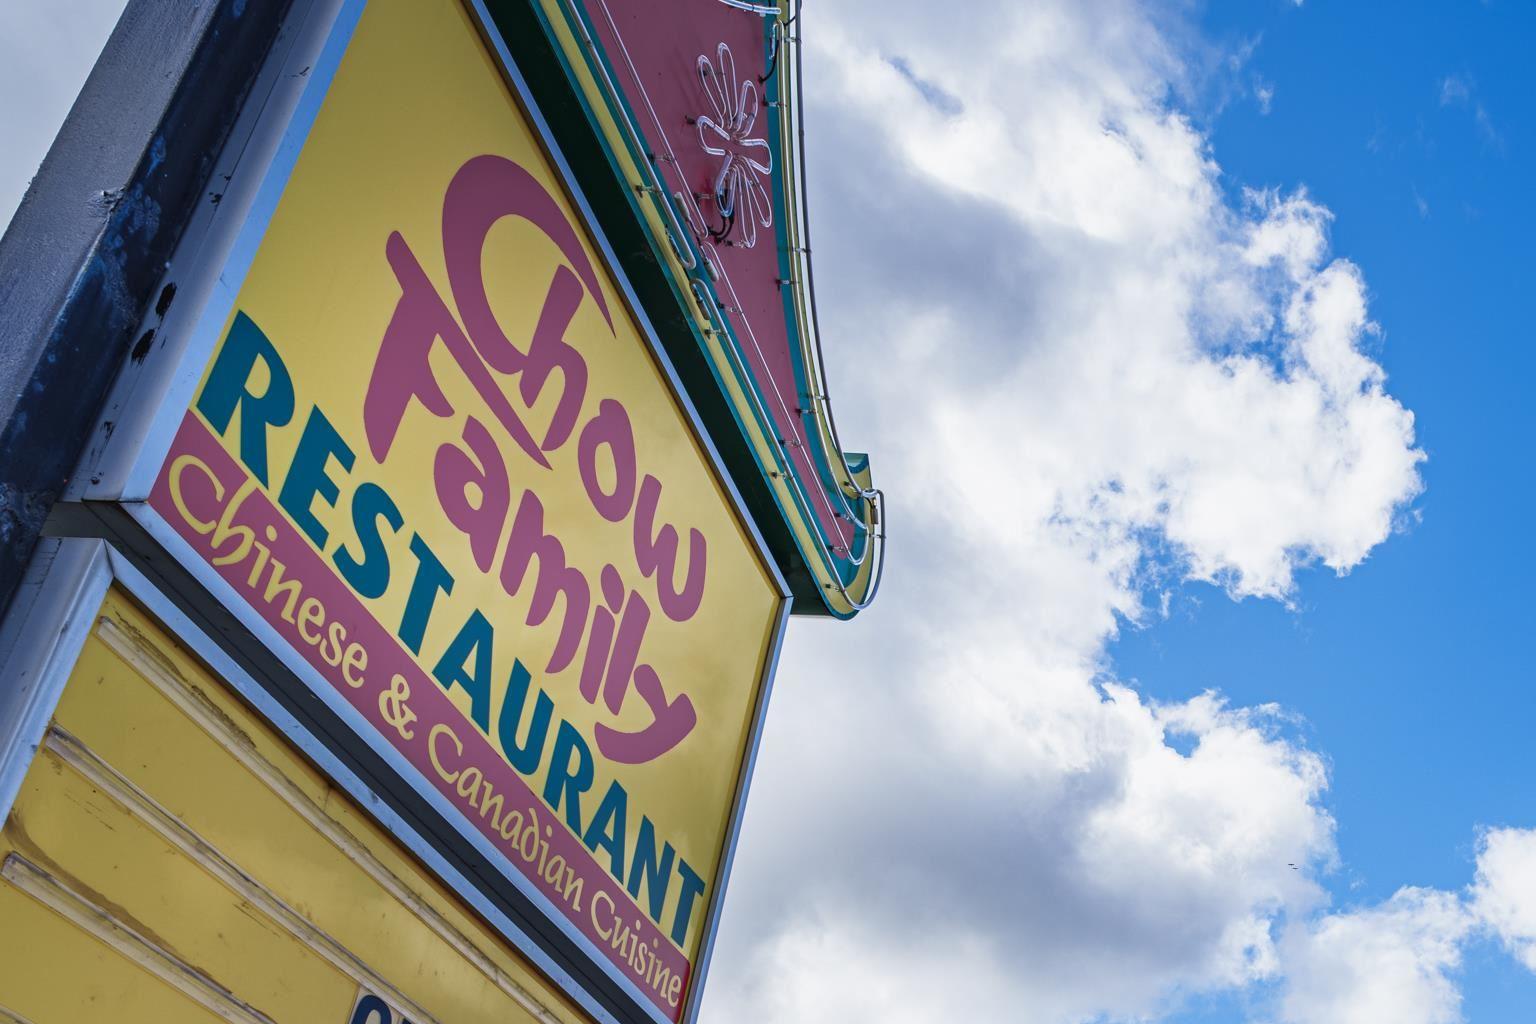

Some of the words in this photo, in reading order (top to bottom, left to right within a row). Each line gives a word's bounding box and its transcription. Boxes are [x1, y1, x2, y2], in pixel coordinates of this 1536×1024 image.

[196, 310, 706, 949] RESTAURANT
[364, 231, 697, 765] Family
[441, 154, 707, 622] Chow
[168, 454, 370, 686] Chinese
[379, 674, 415, 742] &
[429, 722, 588, 912] Canadian
[592, 890, 683, 1006] Cuisine
